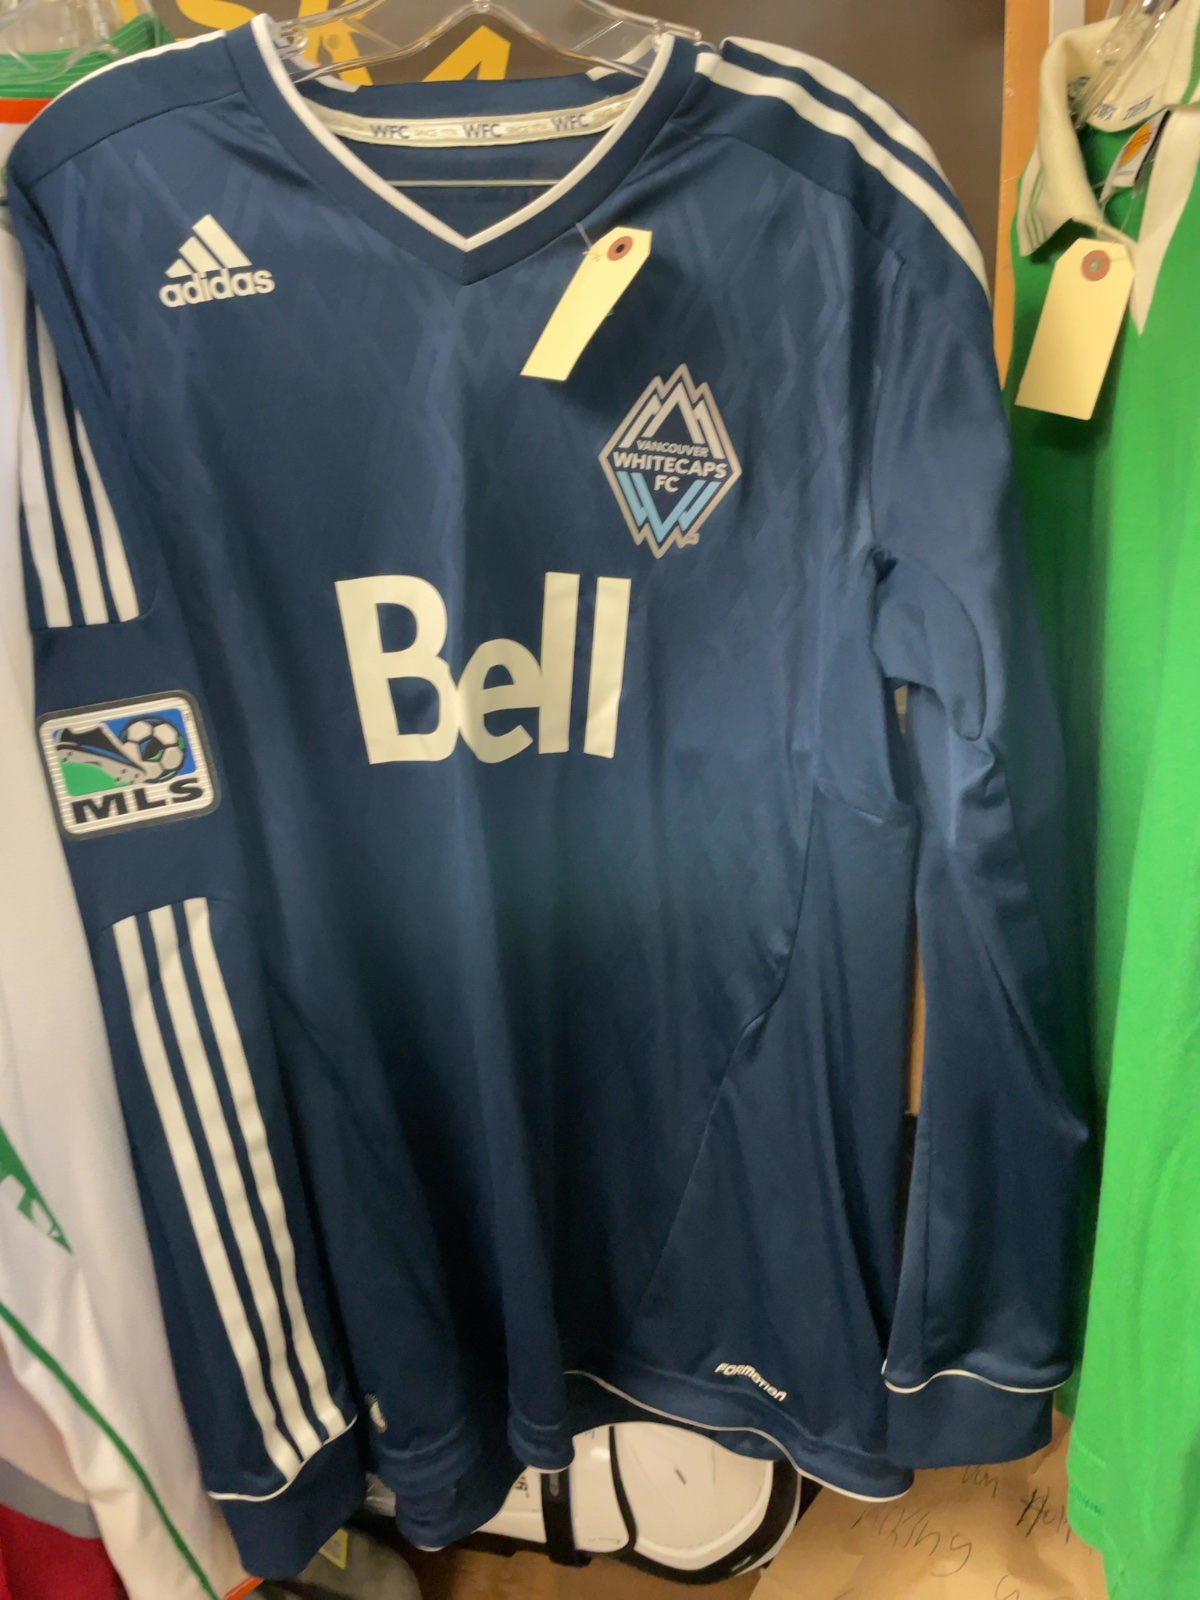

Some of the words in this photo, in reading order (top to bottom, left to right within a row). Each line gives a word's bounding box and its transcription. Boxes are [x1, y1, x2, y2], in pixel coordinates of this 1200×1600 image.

[369, 124, 410, 139] WFC
[462, 123, 502, 138] WFC
[551, 113, 589, 131] WFC
[159, 268, 276, 308] adidas
[636, 440, 709, 458] VANCOUVER
[612, 451, 729, 479] WHITECAPS
[654, 474, 681, 493] FC
[334, 571, 632, 764] Bell
[72, 778, 204, 824] MLS
